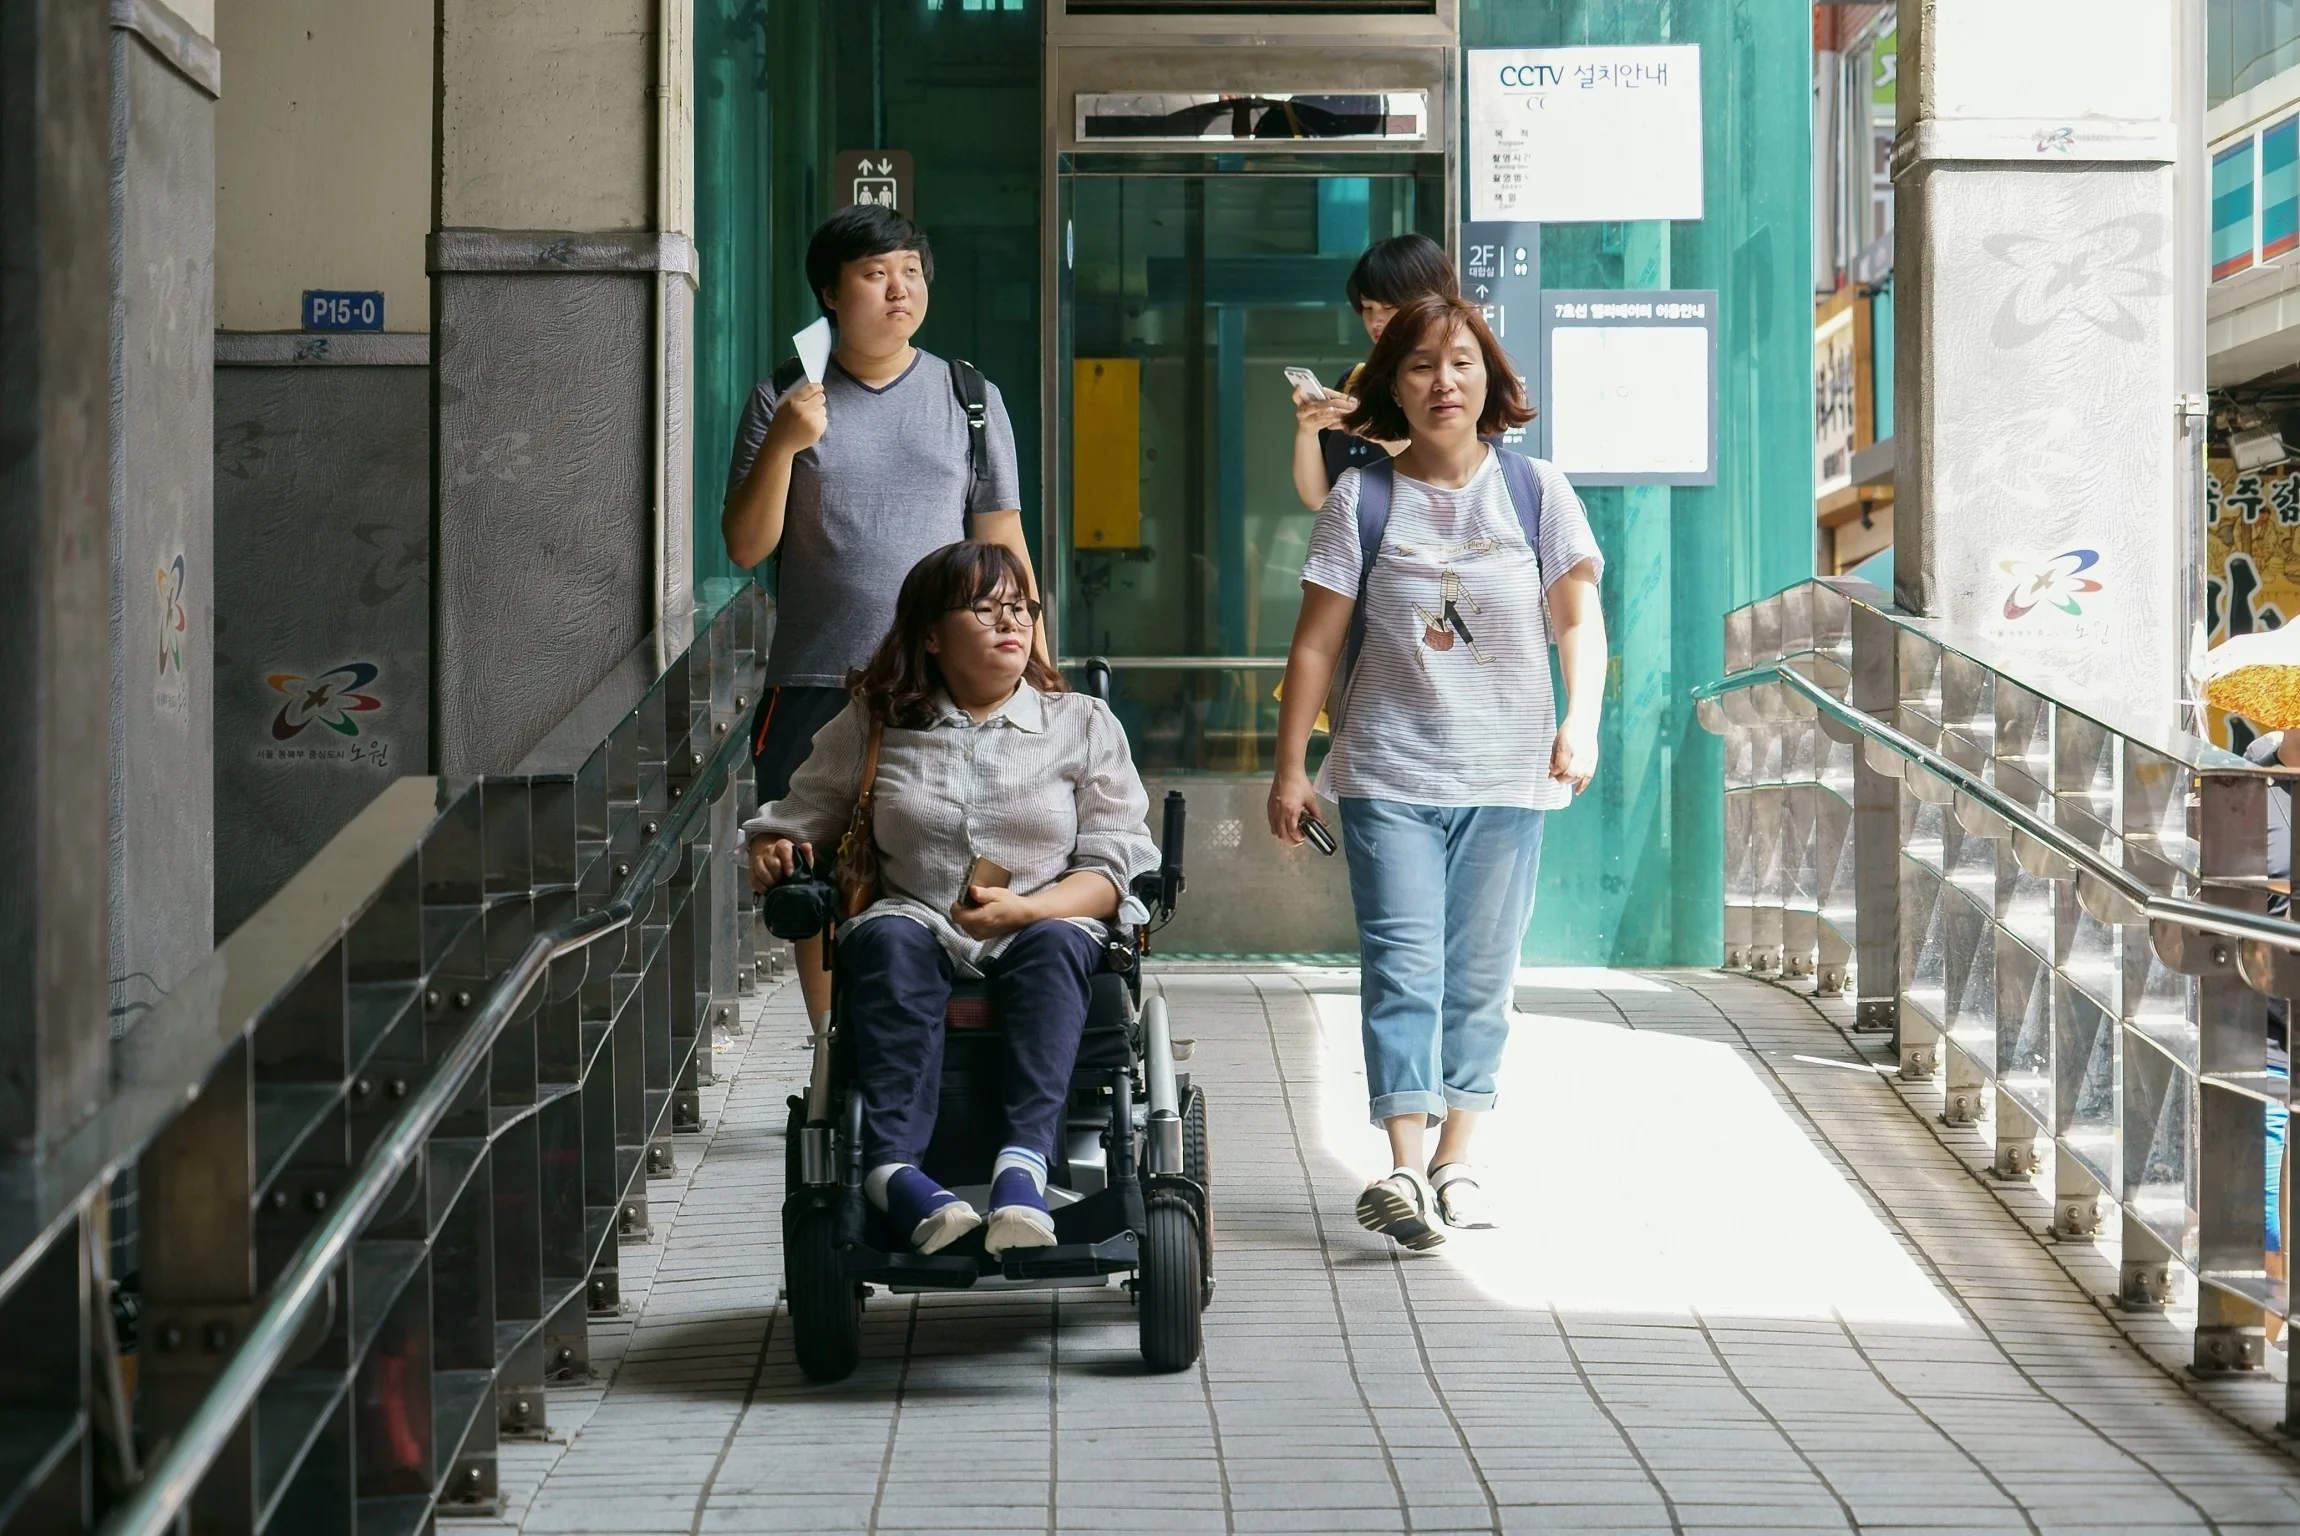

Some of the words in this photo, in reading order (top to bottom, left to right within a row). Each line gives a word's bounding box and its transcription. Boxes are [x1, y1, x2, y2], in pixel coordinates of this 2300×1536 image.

[1500, 65, 1564, 87] CCTV
[1574, 63, 1667, 89] 설치안내
[1469, 245, 1495, 266] 2F
[1469, 266, 1495, 278] 대합실
[313, 298, 375, 324] P15-0
[308, 750, 345, 760] 중심도시
[349, 740, 387, 768] 노원
